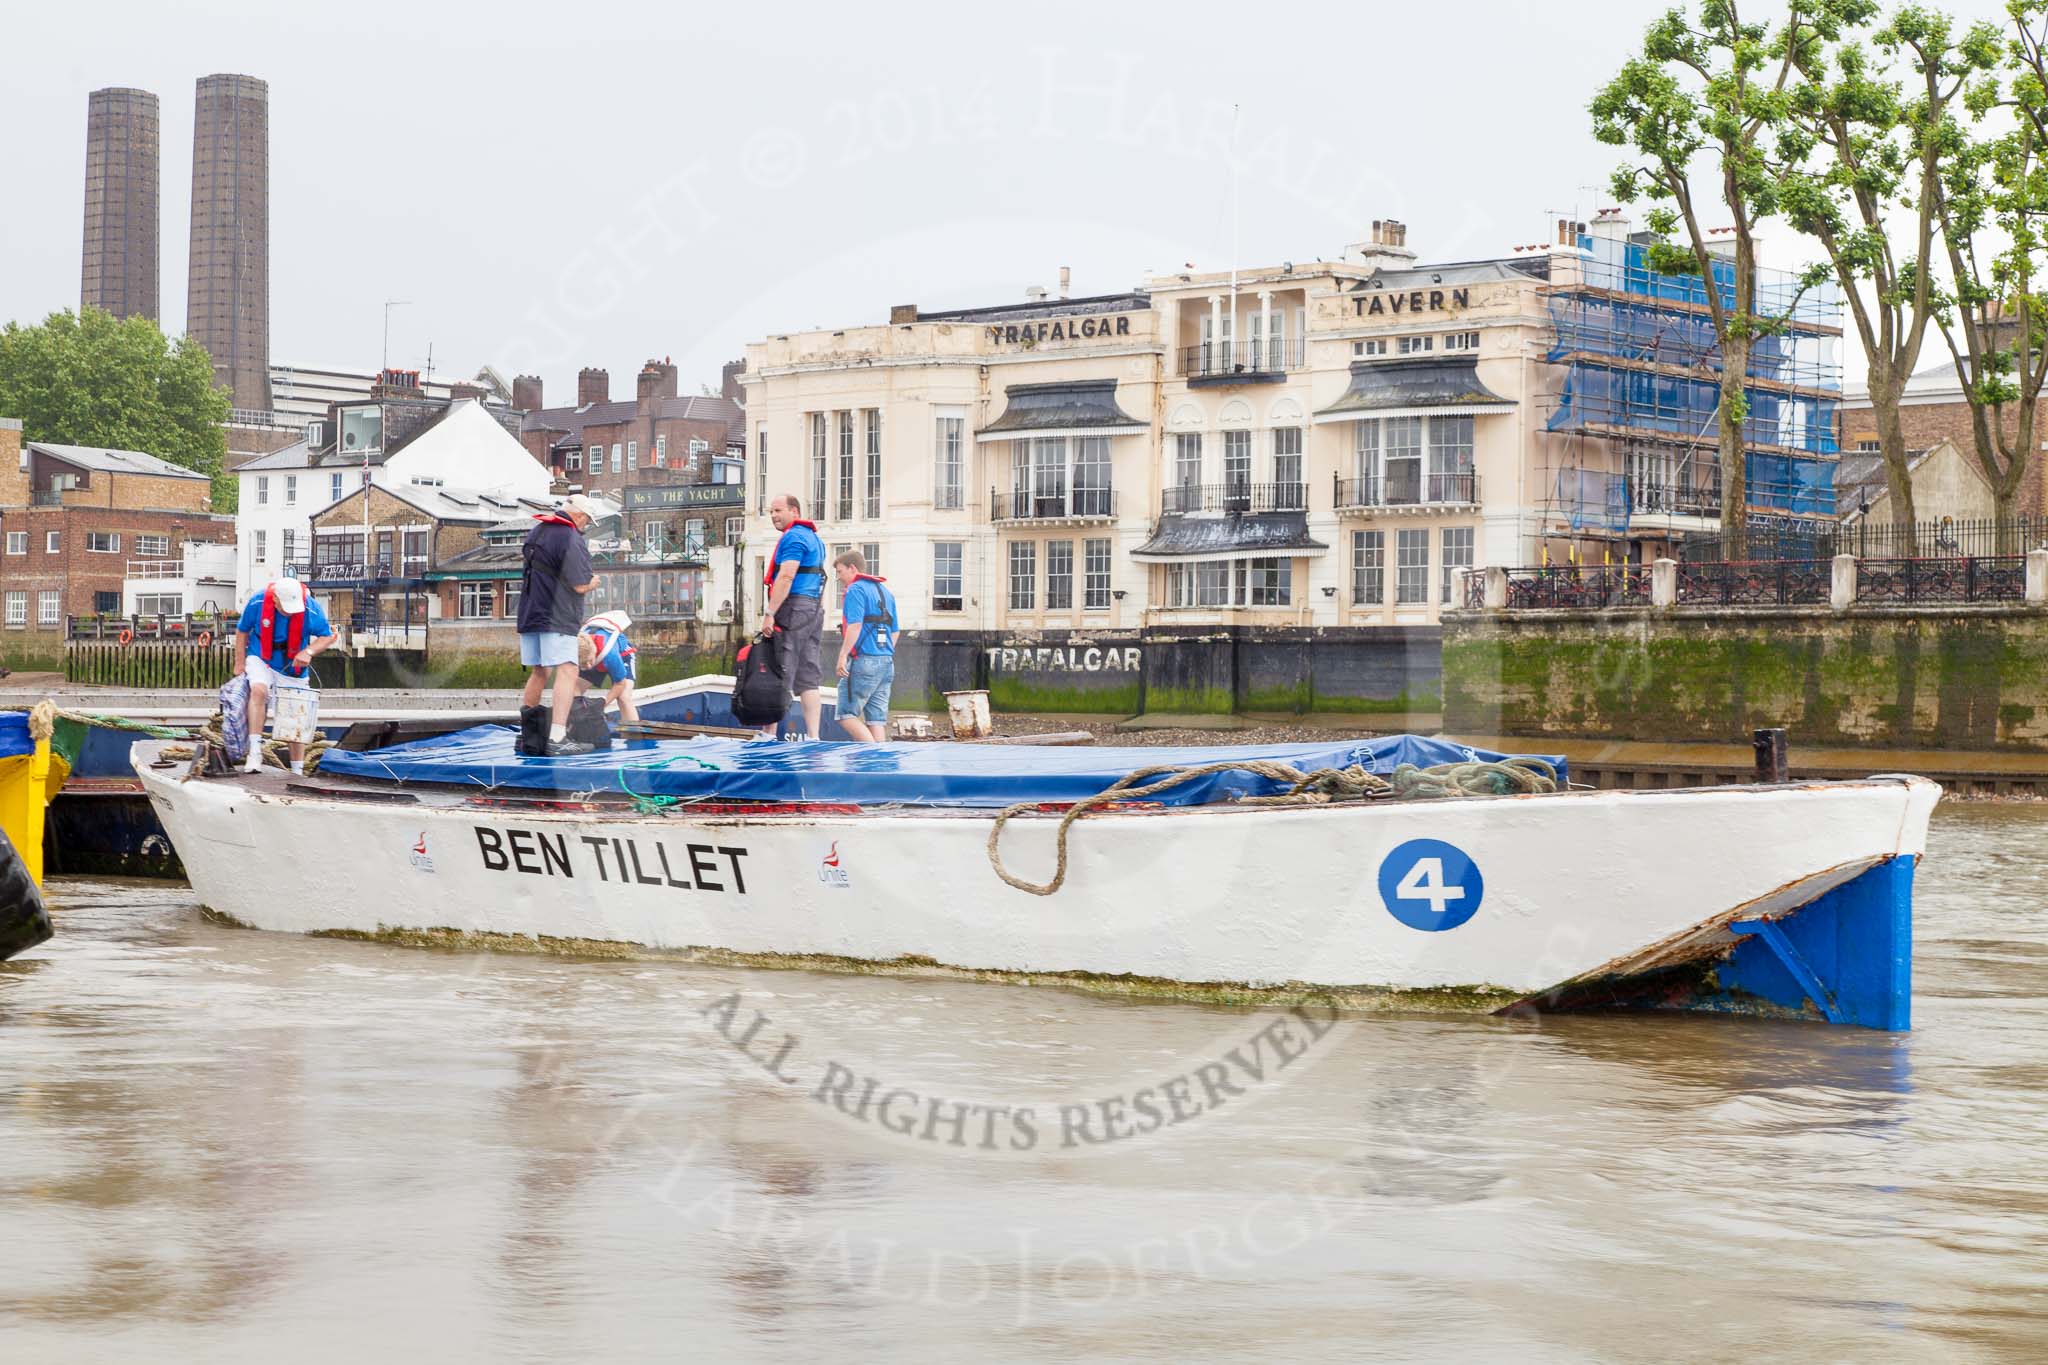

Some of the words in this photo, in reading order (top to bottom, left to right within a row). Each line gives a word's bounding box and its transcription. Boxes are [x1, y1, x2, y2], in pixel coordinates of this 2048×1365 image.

[1352, 288, 1469, 316] TAVERN
[991, 316, 1130, 345] TRAFALGAR
[662, 490, 684, 502] THE
[689, 488, 726, 500] YACHT
[986, 647, 1141, 672] TRAFALGAR
[474, 826, 573, 878] BEN
[580, 835, 748, 894] TILLET
[1396, 857, 1465, 912] 4
